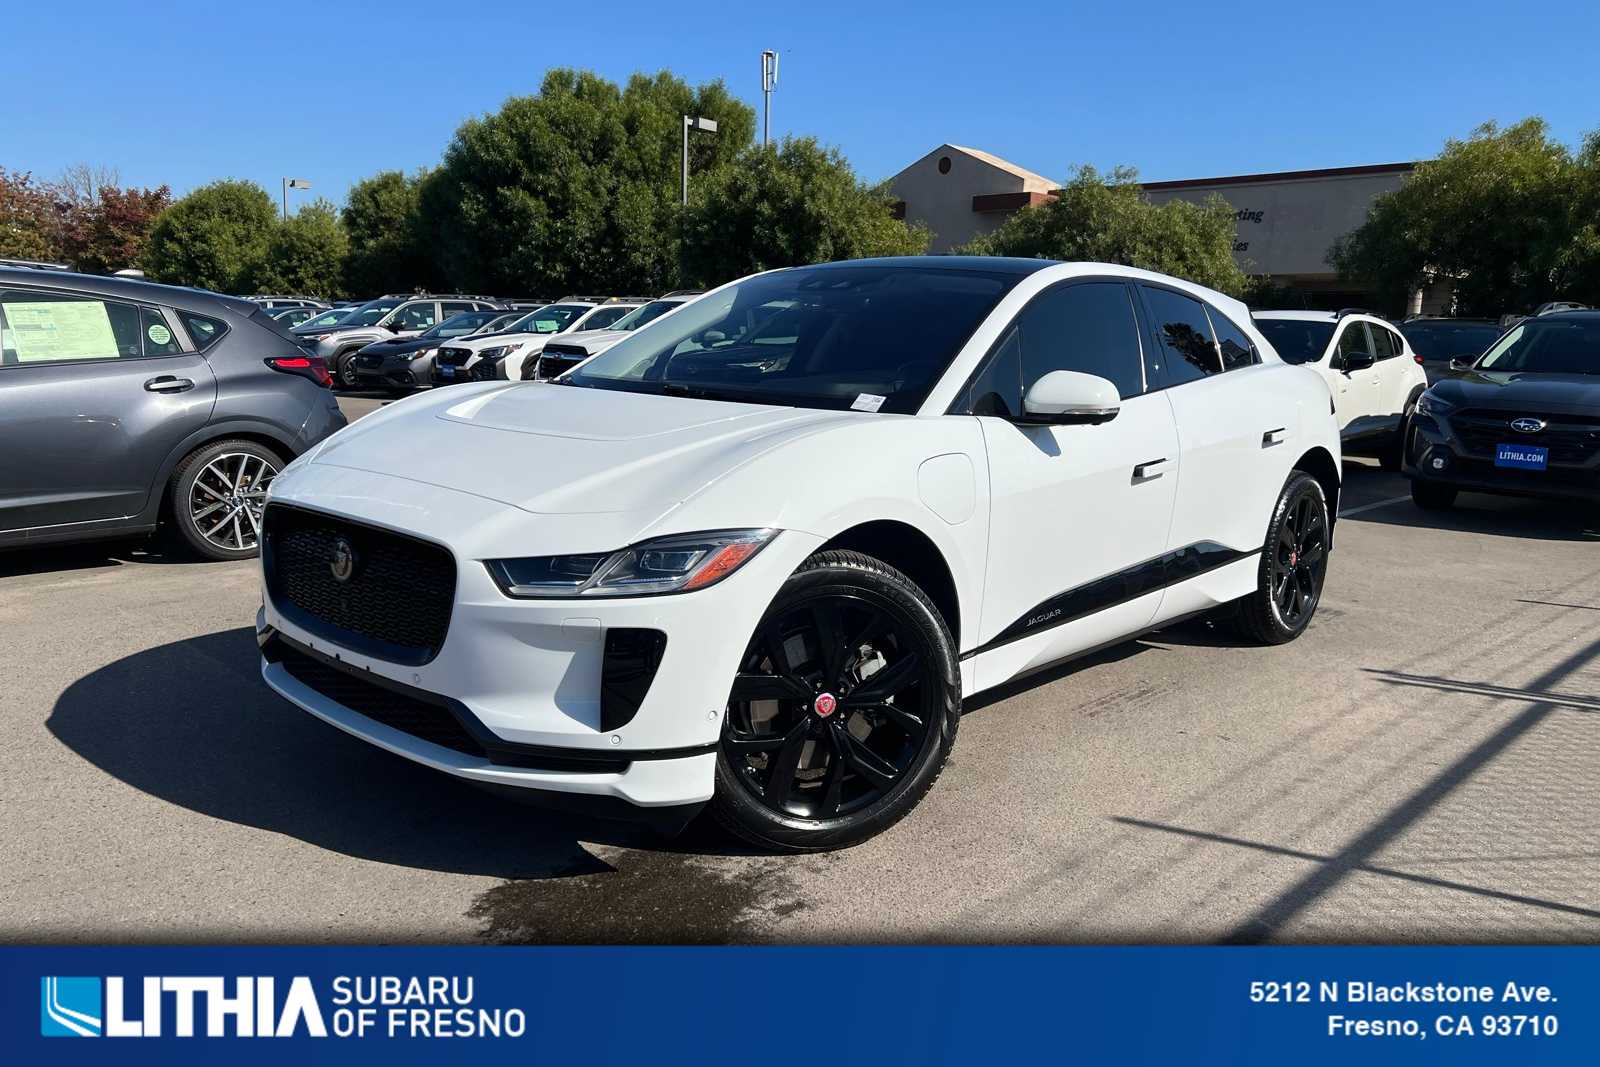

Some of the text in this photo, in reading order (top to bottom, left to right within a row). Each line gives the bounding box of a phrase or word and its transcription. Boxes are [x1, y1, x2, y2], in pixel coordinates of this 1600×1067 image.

[1235, 208, 1265, 224] ting
[1231, 239, 1249, 251] ies
[1499, 451, 1544, 463] LITHIA.COM
[1026, 608, 1062, 627] JAGUAR
